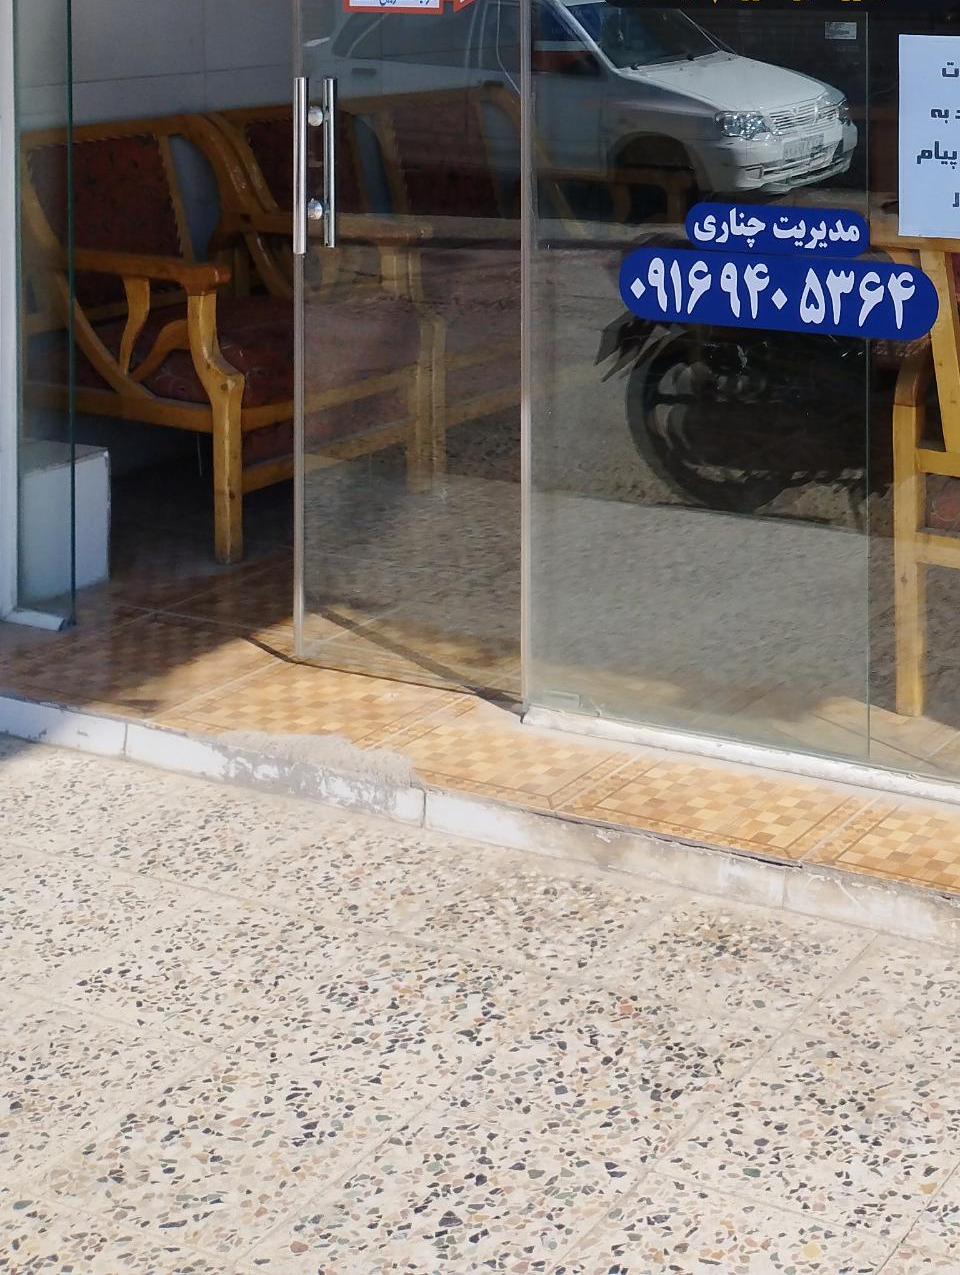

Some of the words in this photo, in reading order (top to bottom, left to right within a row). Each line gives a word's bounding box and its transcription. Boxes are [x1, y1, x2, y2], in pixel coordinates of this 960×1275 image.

[930, 106, 950, 124] به
[916, 140, 958, 170] پیام
[693, 208, 766, 246] چناری
[772, 213, 860, 249] مدیریت
